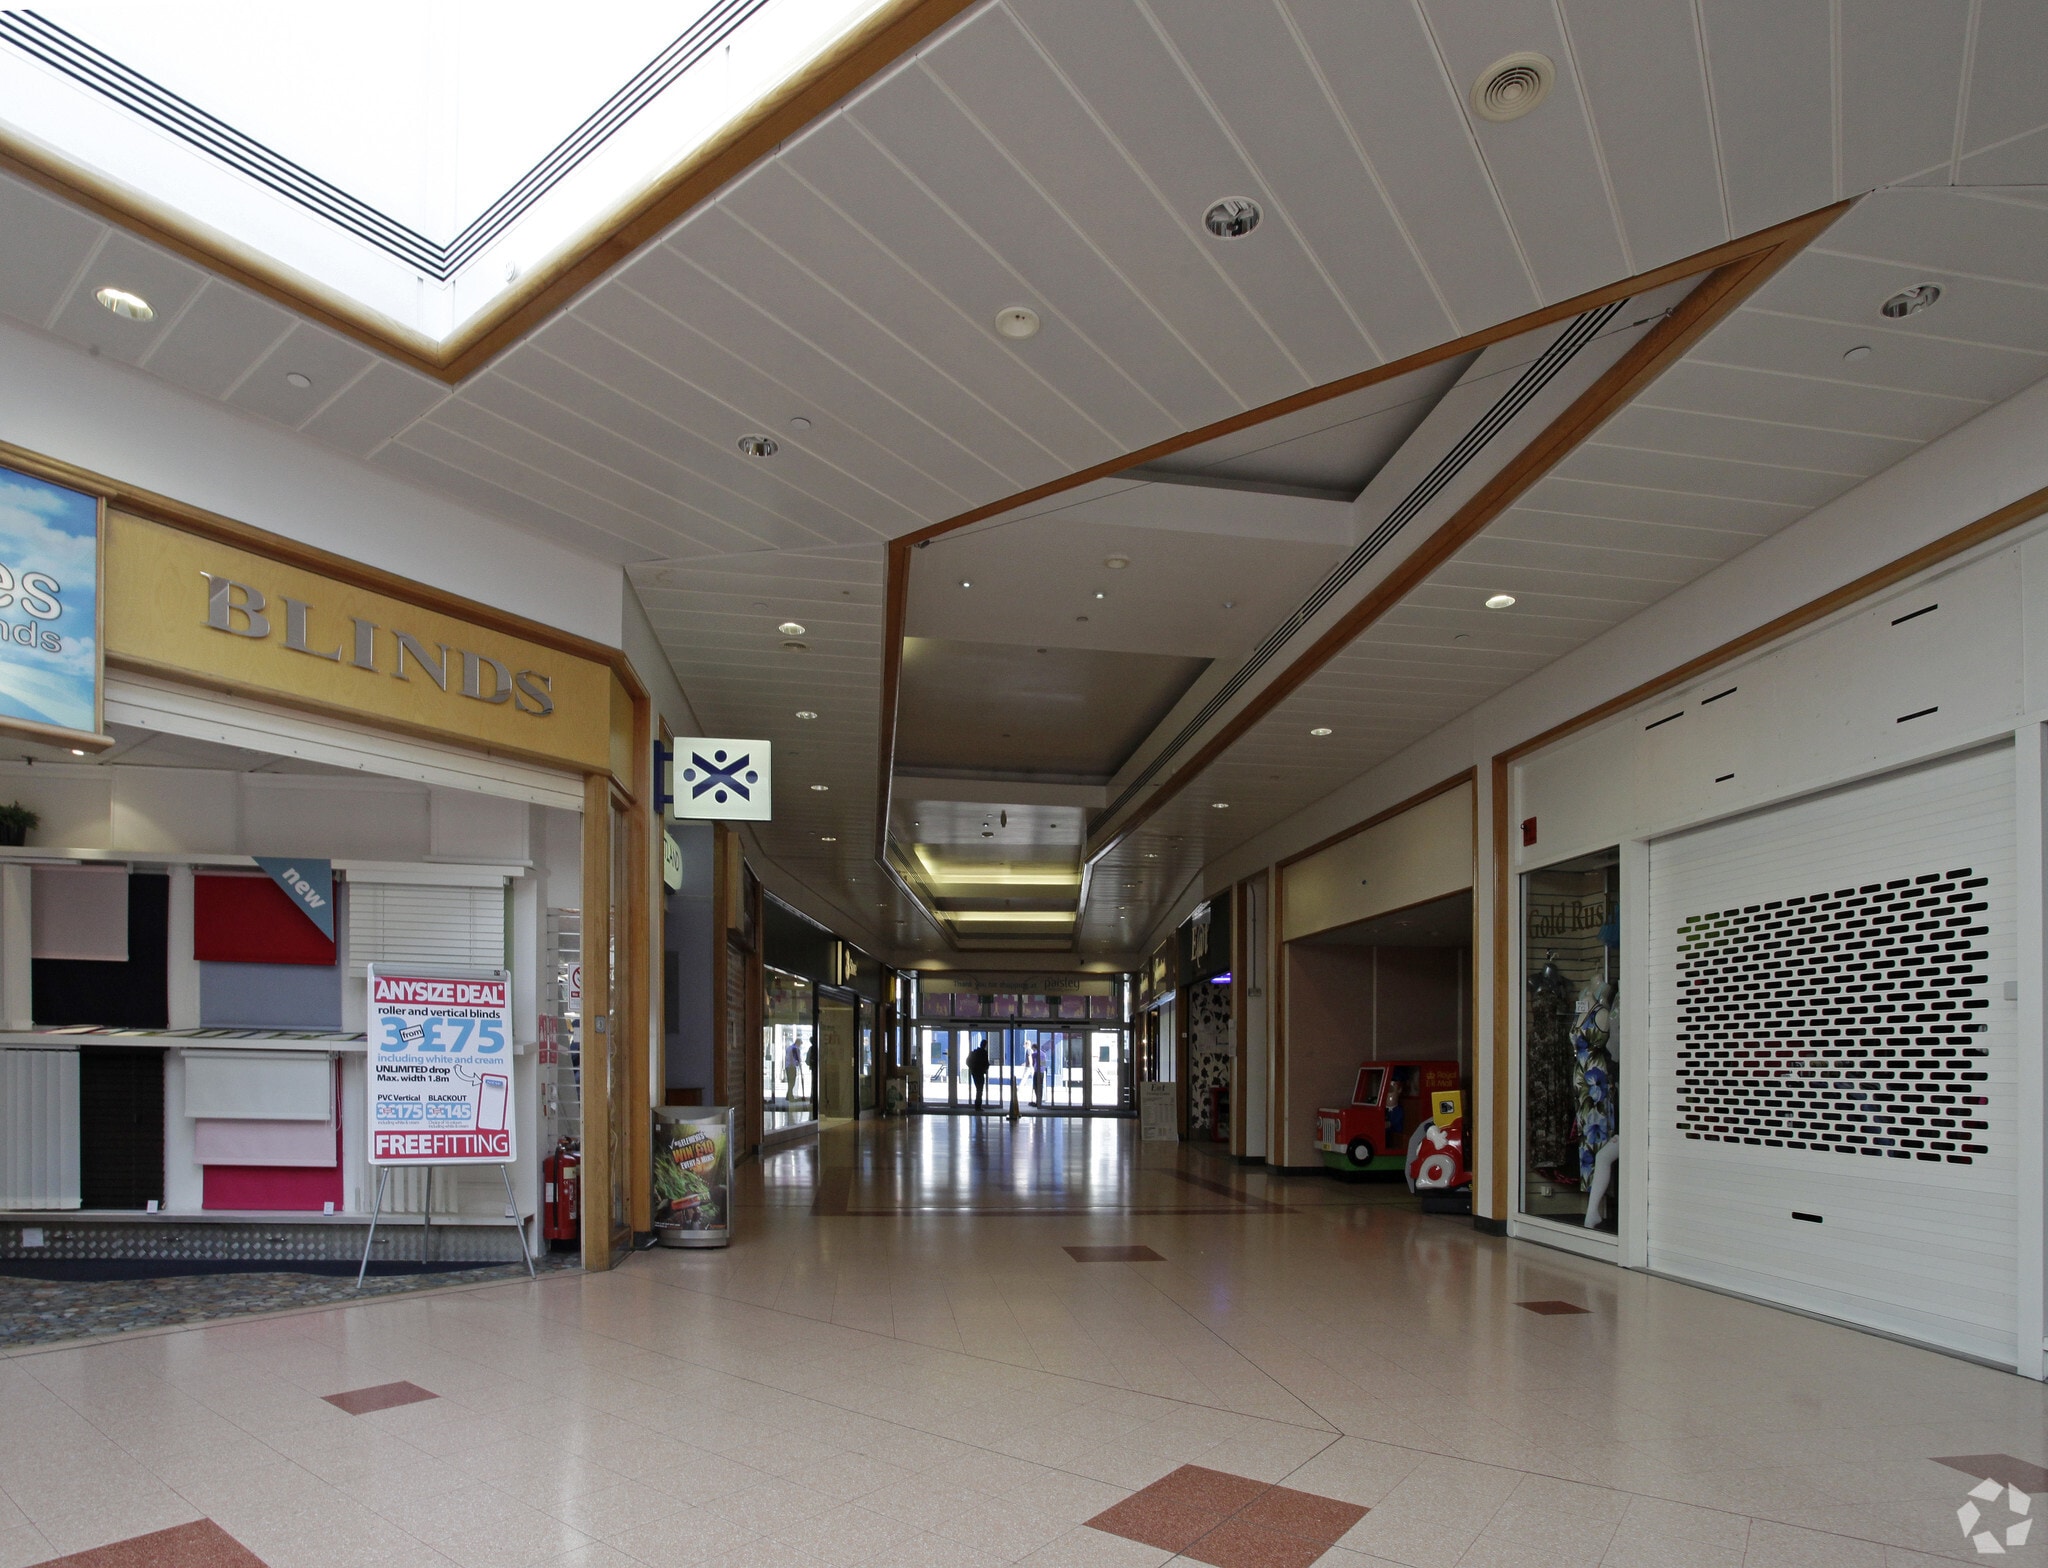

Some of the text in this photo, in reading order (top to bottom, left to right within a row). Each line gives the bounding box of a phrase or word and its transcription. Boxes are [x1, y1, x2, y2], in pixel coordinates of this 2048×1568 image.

[200, 571, 555, 717] BLINDS
[282, 868, 326, 908] new
[1529, 893, 1617, 939] Gold Rush
[1044, 977, 1080, 990] paisley
[378, 1006, 501, 1019] roller and vertical blinds
[380, 1017, 408, 1053] 3
[402, 1028, 423, 1039] from
[418, 1017, 505, 1054] £75
[378, 1053, 504, 1065] including white and cream
[376, 1065, 451, 1075] UNLIMITED drop
[1437, 1071, 1457, 1080] Royal
[377, 1074, 400, 1082] Max.
[400, 1074, 427, 1082] width
[672, 1145, 694, 1163] WIN
[680, 1159, 696, 1169] EVERY
